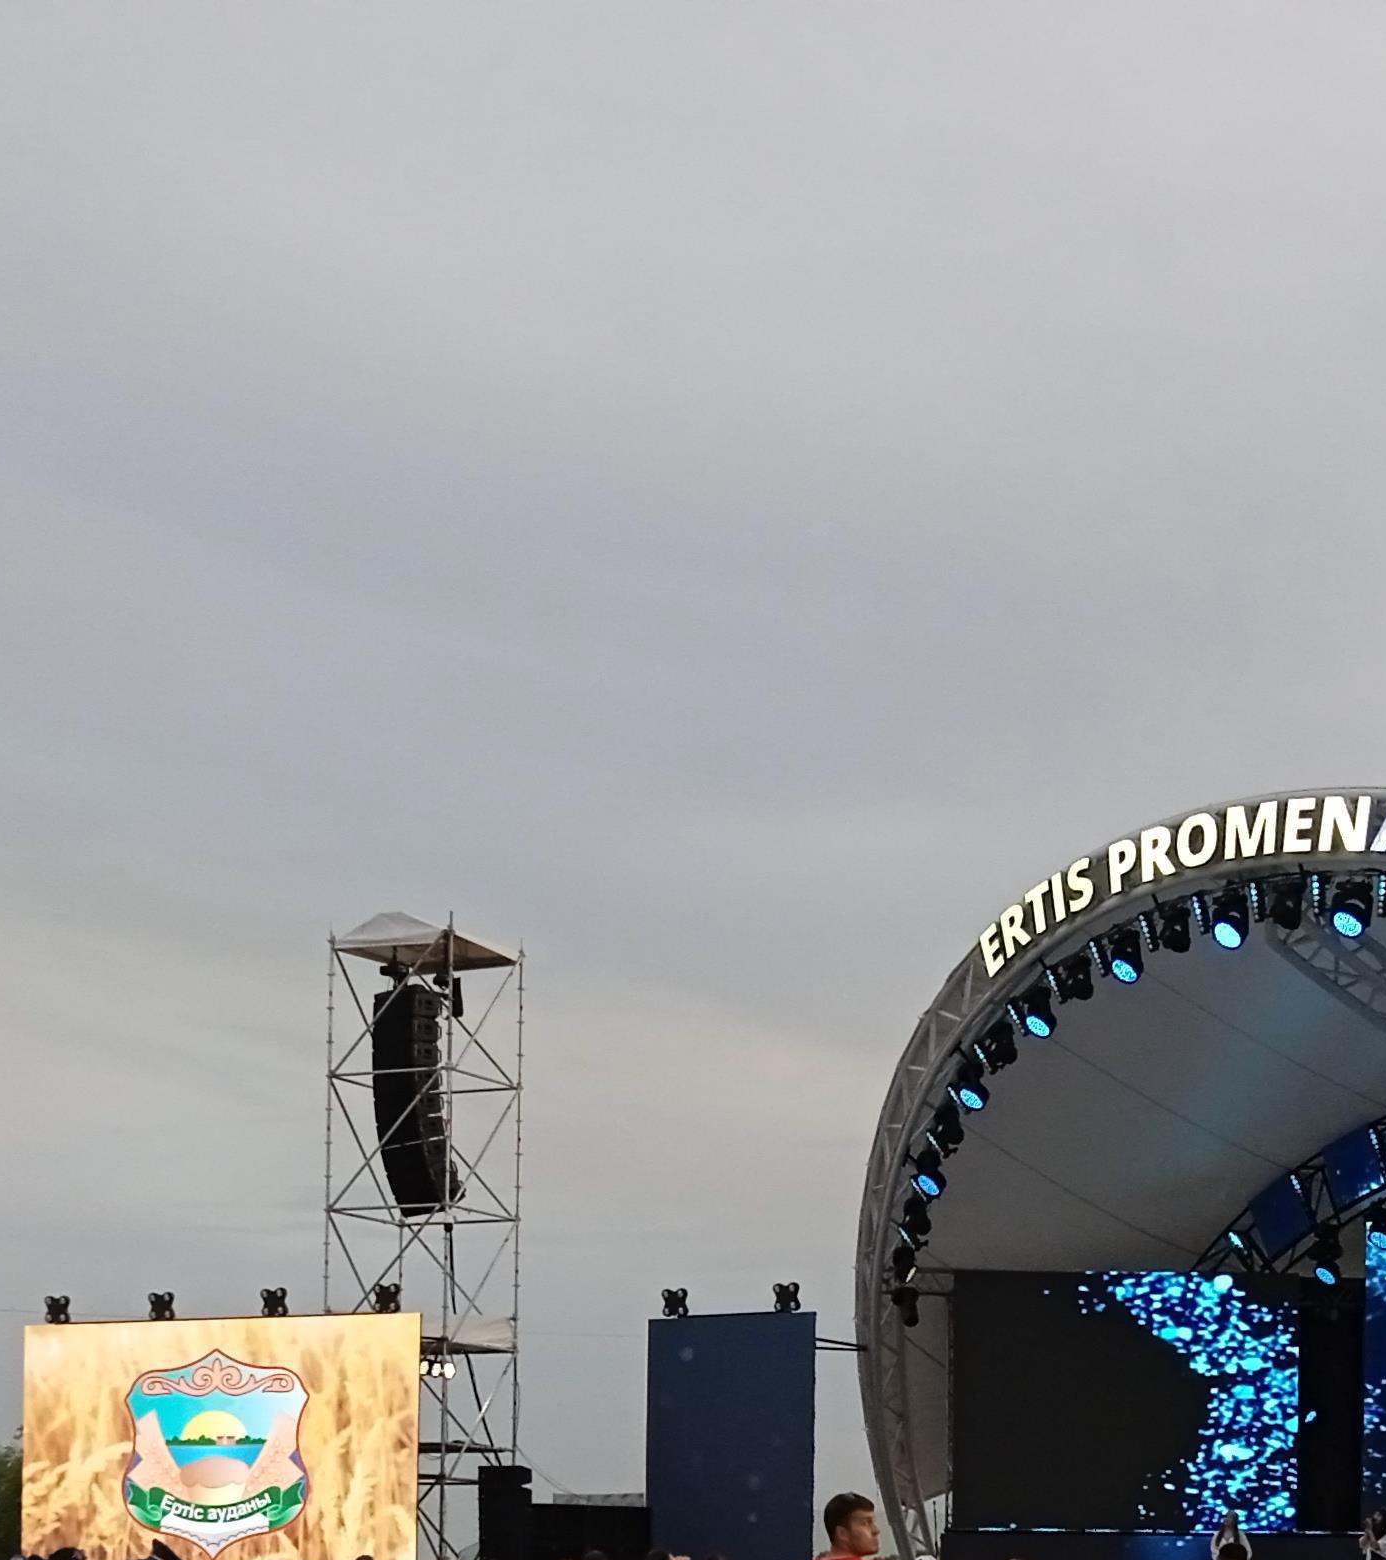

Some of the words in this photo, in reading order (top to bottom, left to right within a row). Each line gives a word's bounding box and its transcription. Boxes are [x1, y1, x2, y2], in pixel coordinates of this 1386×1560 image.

[977, 856, 1095, 978] ERTIS
[160, 1494, 205, 1520] Ертіс
[207, 1492, 272, 1523] ауданы
